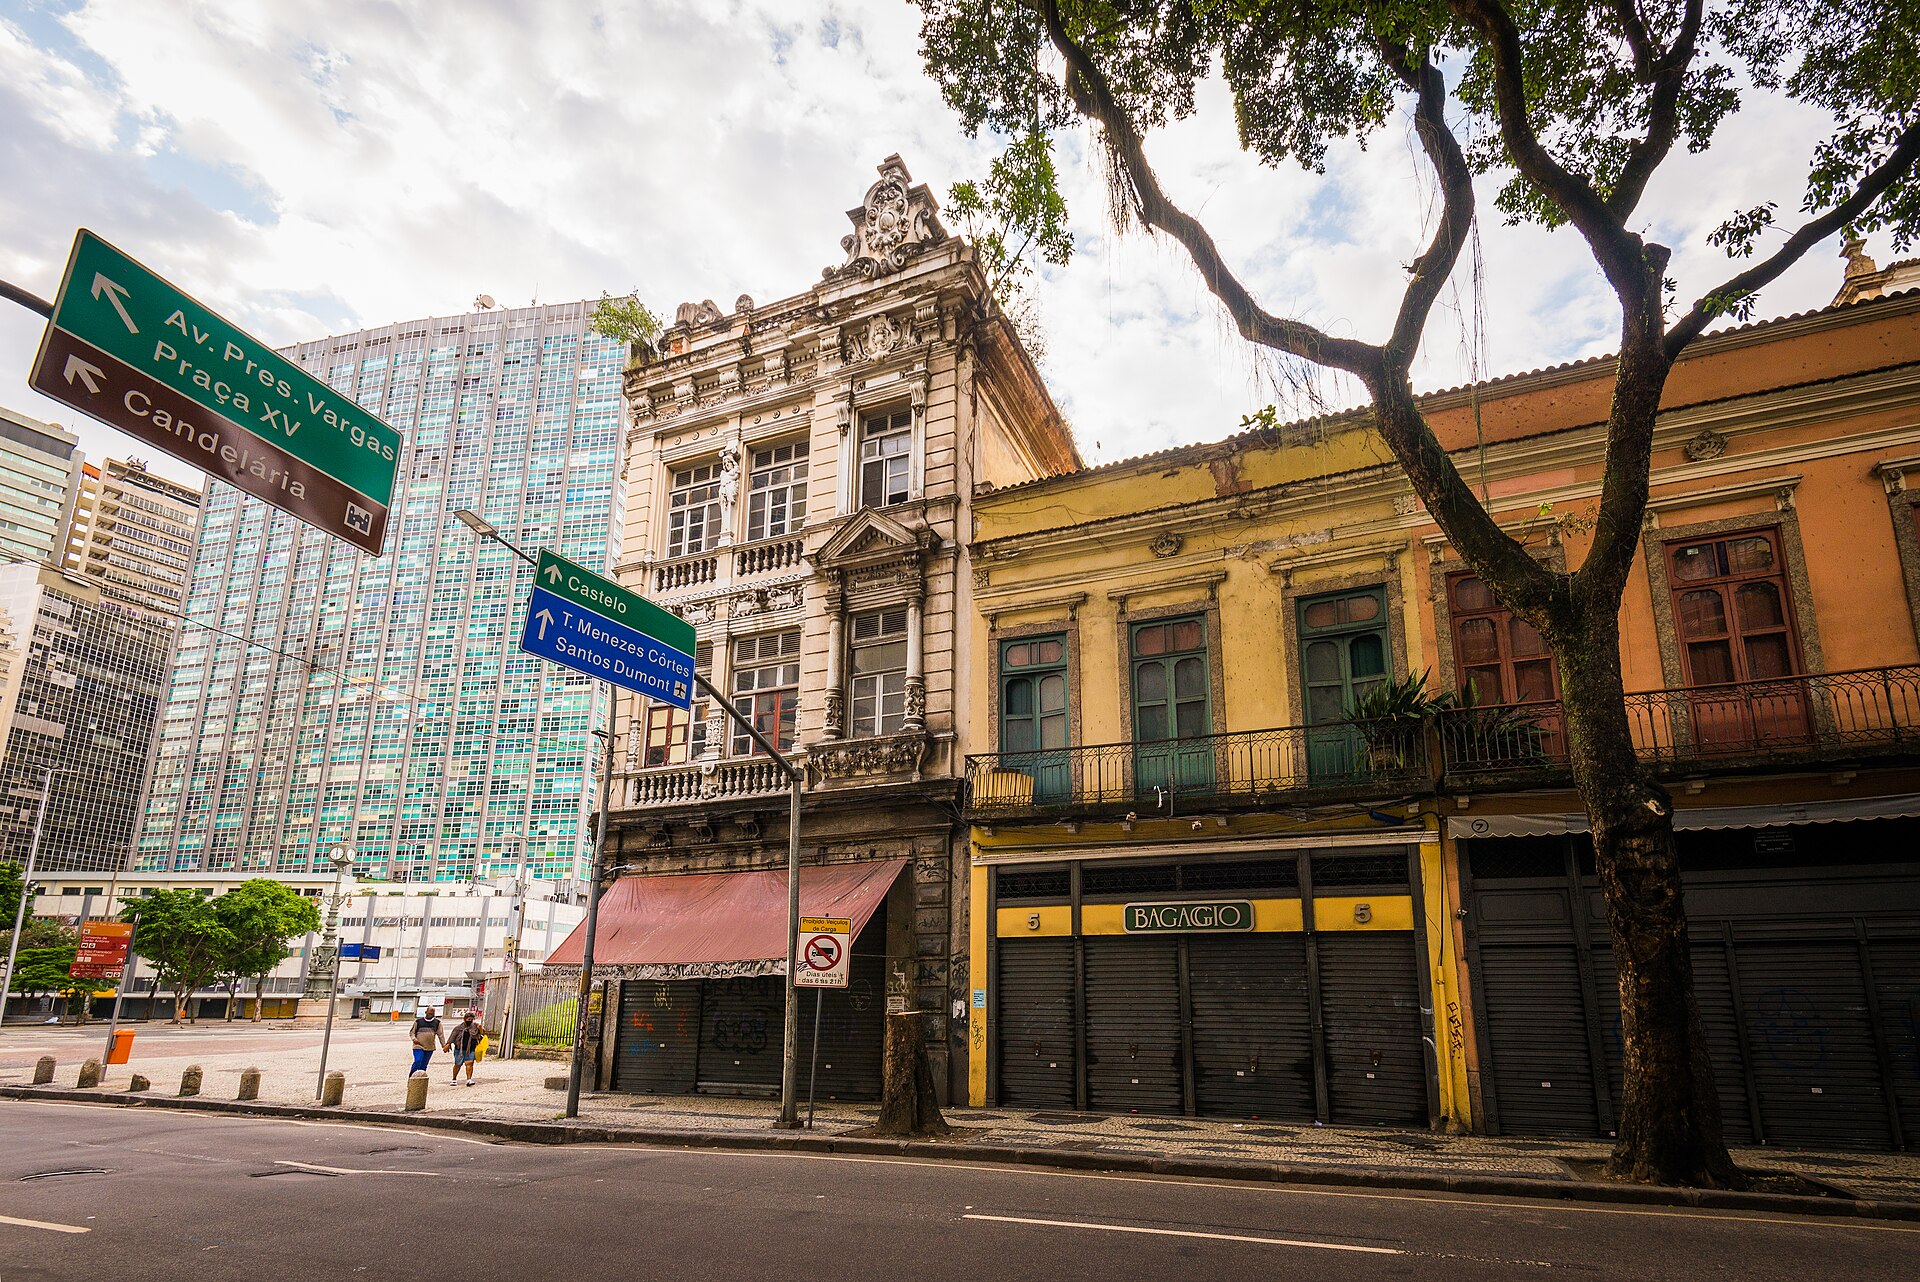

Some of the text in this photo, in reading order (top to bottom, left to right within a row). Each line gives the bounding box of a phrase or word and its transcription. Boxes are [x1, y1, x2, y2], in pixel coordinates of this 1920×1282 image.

[153, 340, 301, 437] Praça XV
[164, 309, 394, 461] Av. Pres. Vargas
[124, 389, 306, 500] Candelária
[568, 576, 627, 614] Castelo
[555, 636, 670, 692] Santos Dumont
[562, 611, 690, 678] T. Menezes Côrtes
[1027, 912, 1040, 931] 5
[1134, 905, 1241, 928] BAGAGGIO
[1354, 903, 1371, 923] 5
